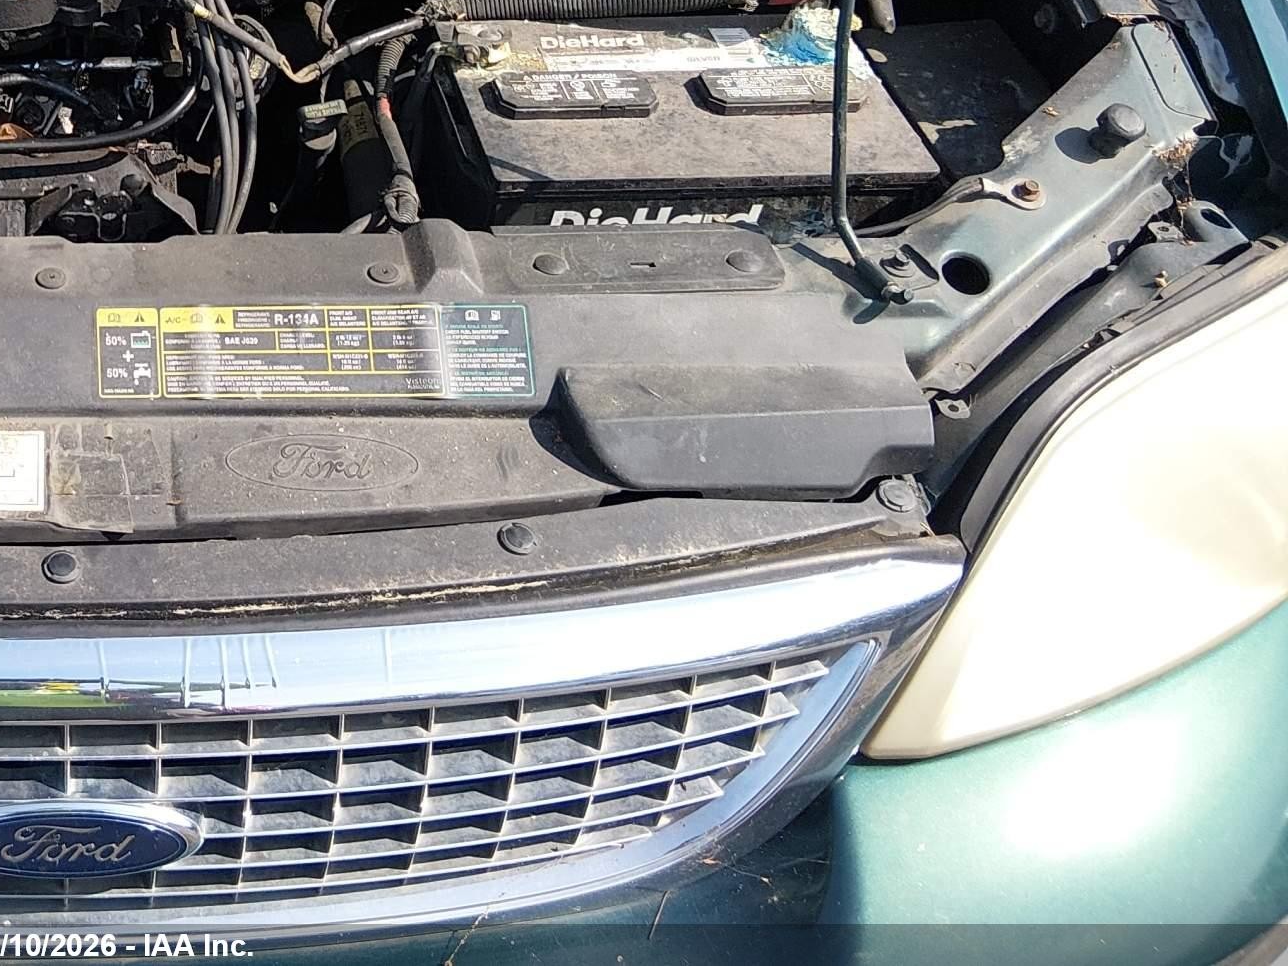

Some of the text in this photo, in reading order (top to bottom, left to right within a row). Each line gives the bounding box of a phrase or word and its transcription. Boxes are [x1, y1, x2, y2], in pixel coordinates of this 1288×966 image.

[539, 34, 645, 49] DieHard
[274, 313, 319, 325] R-134A
[105, 335, 127, 346] 50%
[106, 368, 128, 378] 50%
[273, 443, 371, 479] Ford
[1, 824, 136, 863] Ford
